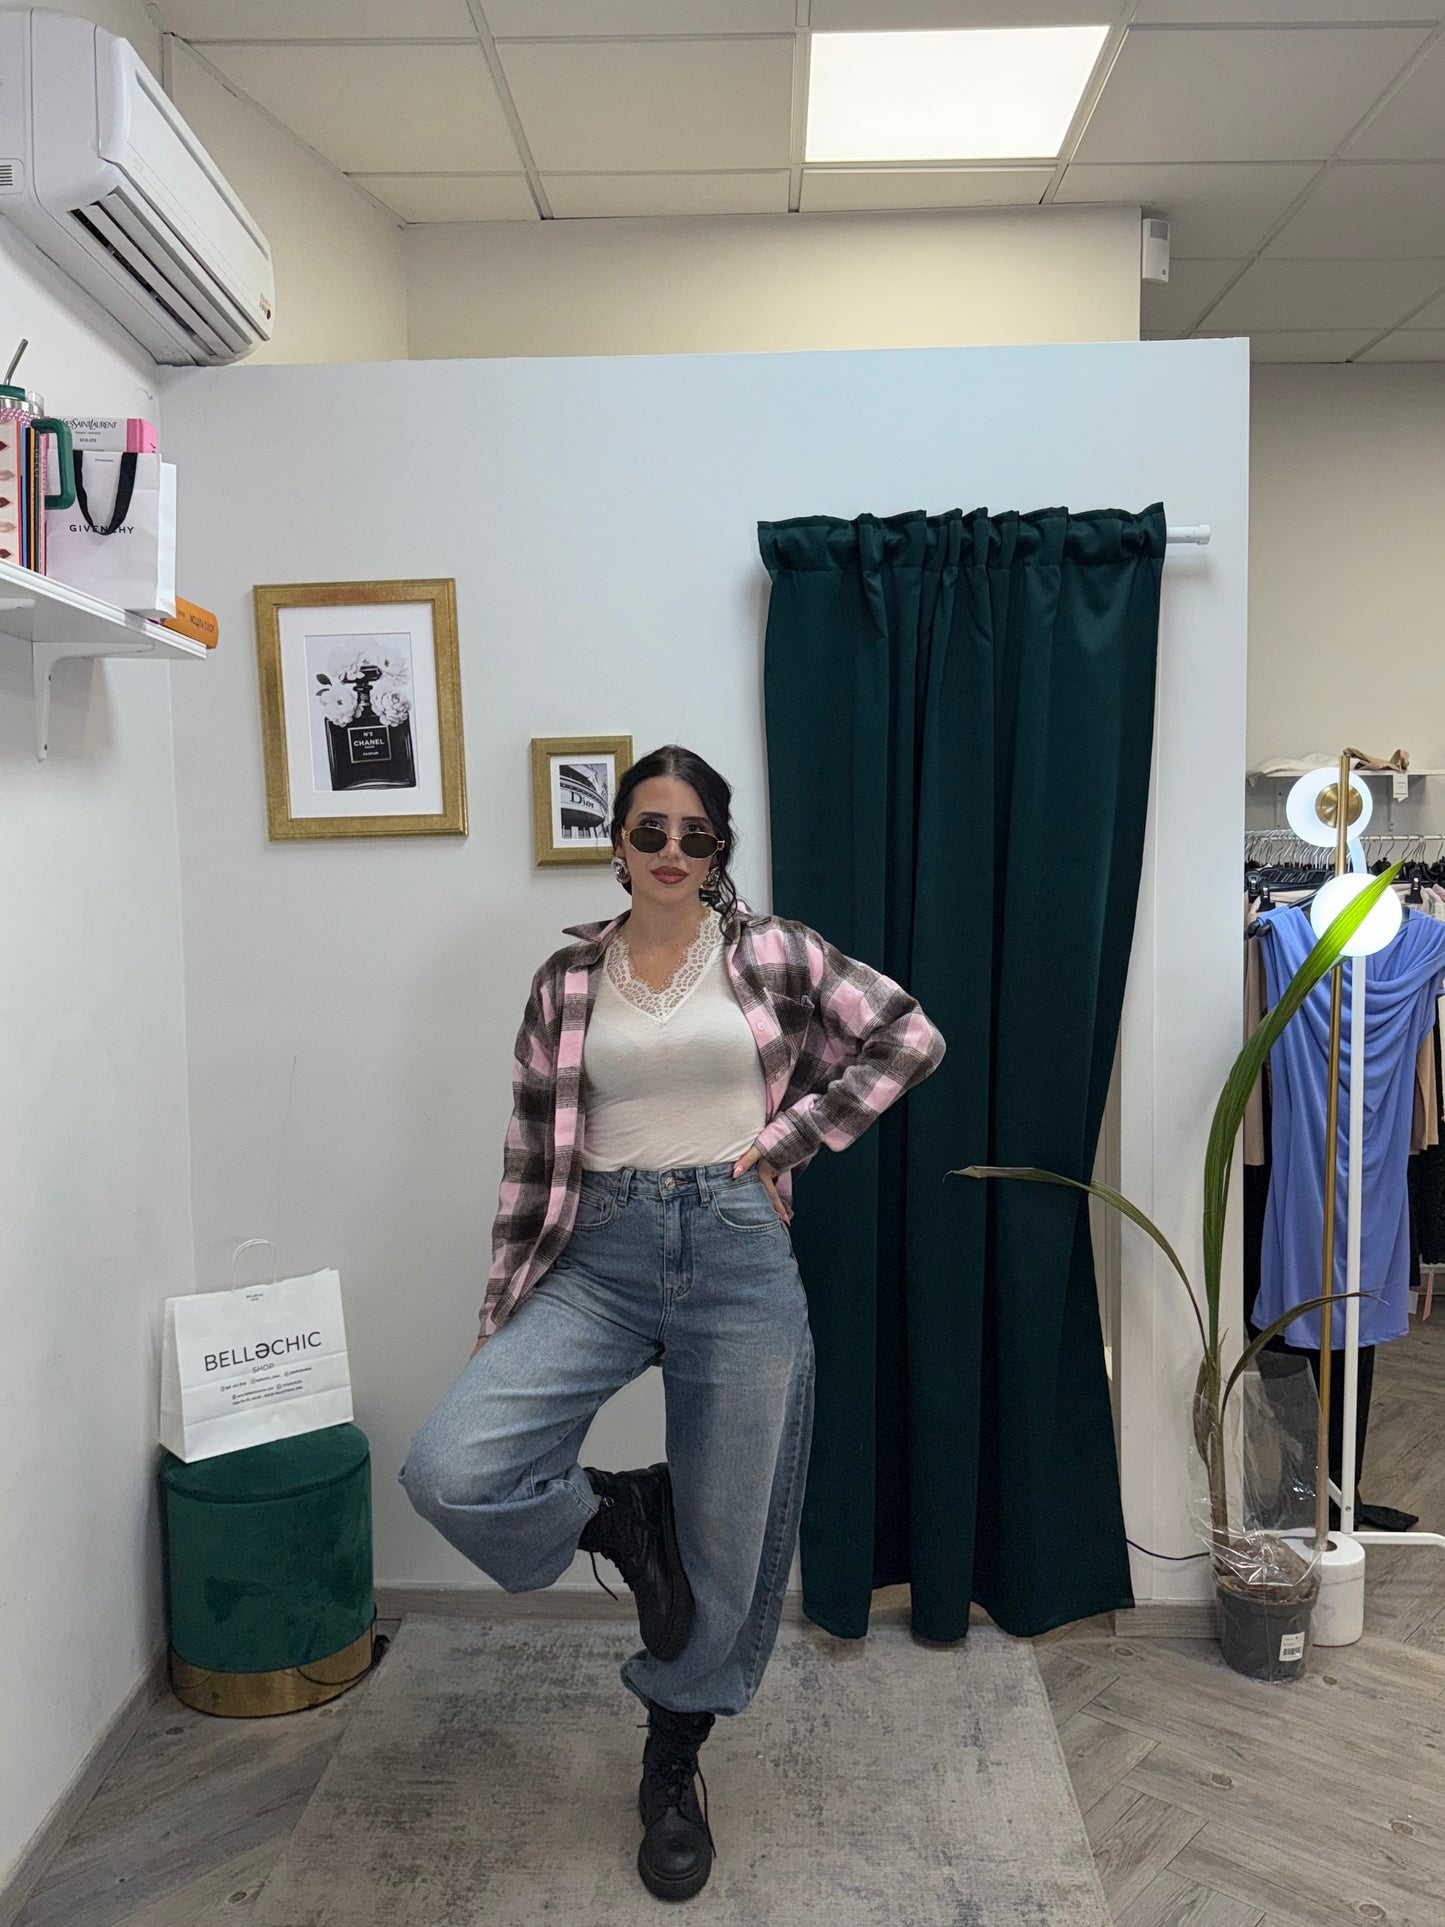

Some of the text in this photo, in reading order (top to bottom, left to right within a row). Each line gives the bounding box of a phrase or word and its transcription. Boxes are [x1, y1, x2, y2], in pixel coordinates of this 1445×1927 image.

[69, 524, 134, 534] GIVENHY
[353, 739, 385, 747] CHANEL
[569, 791, 594, 808] Dior
[252, 1363, 275, 1373] SHOP
